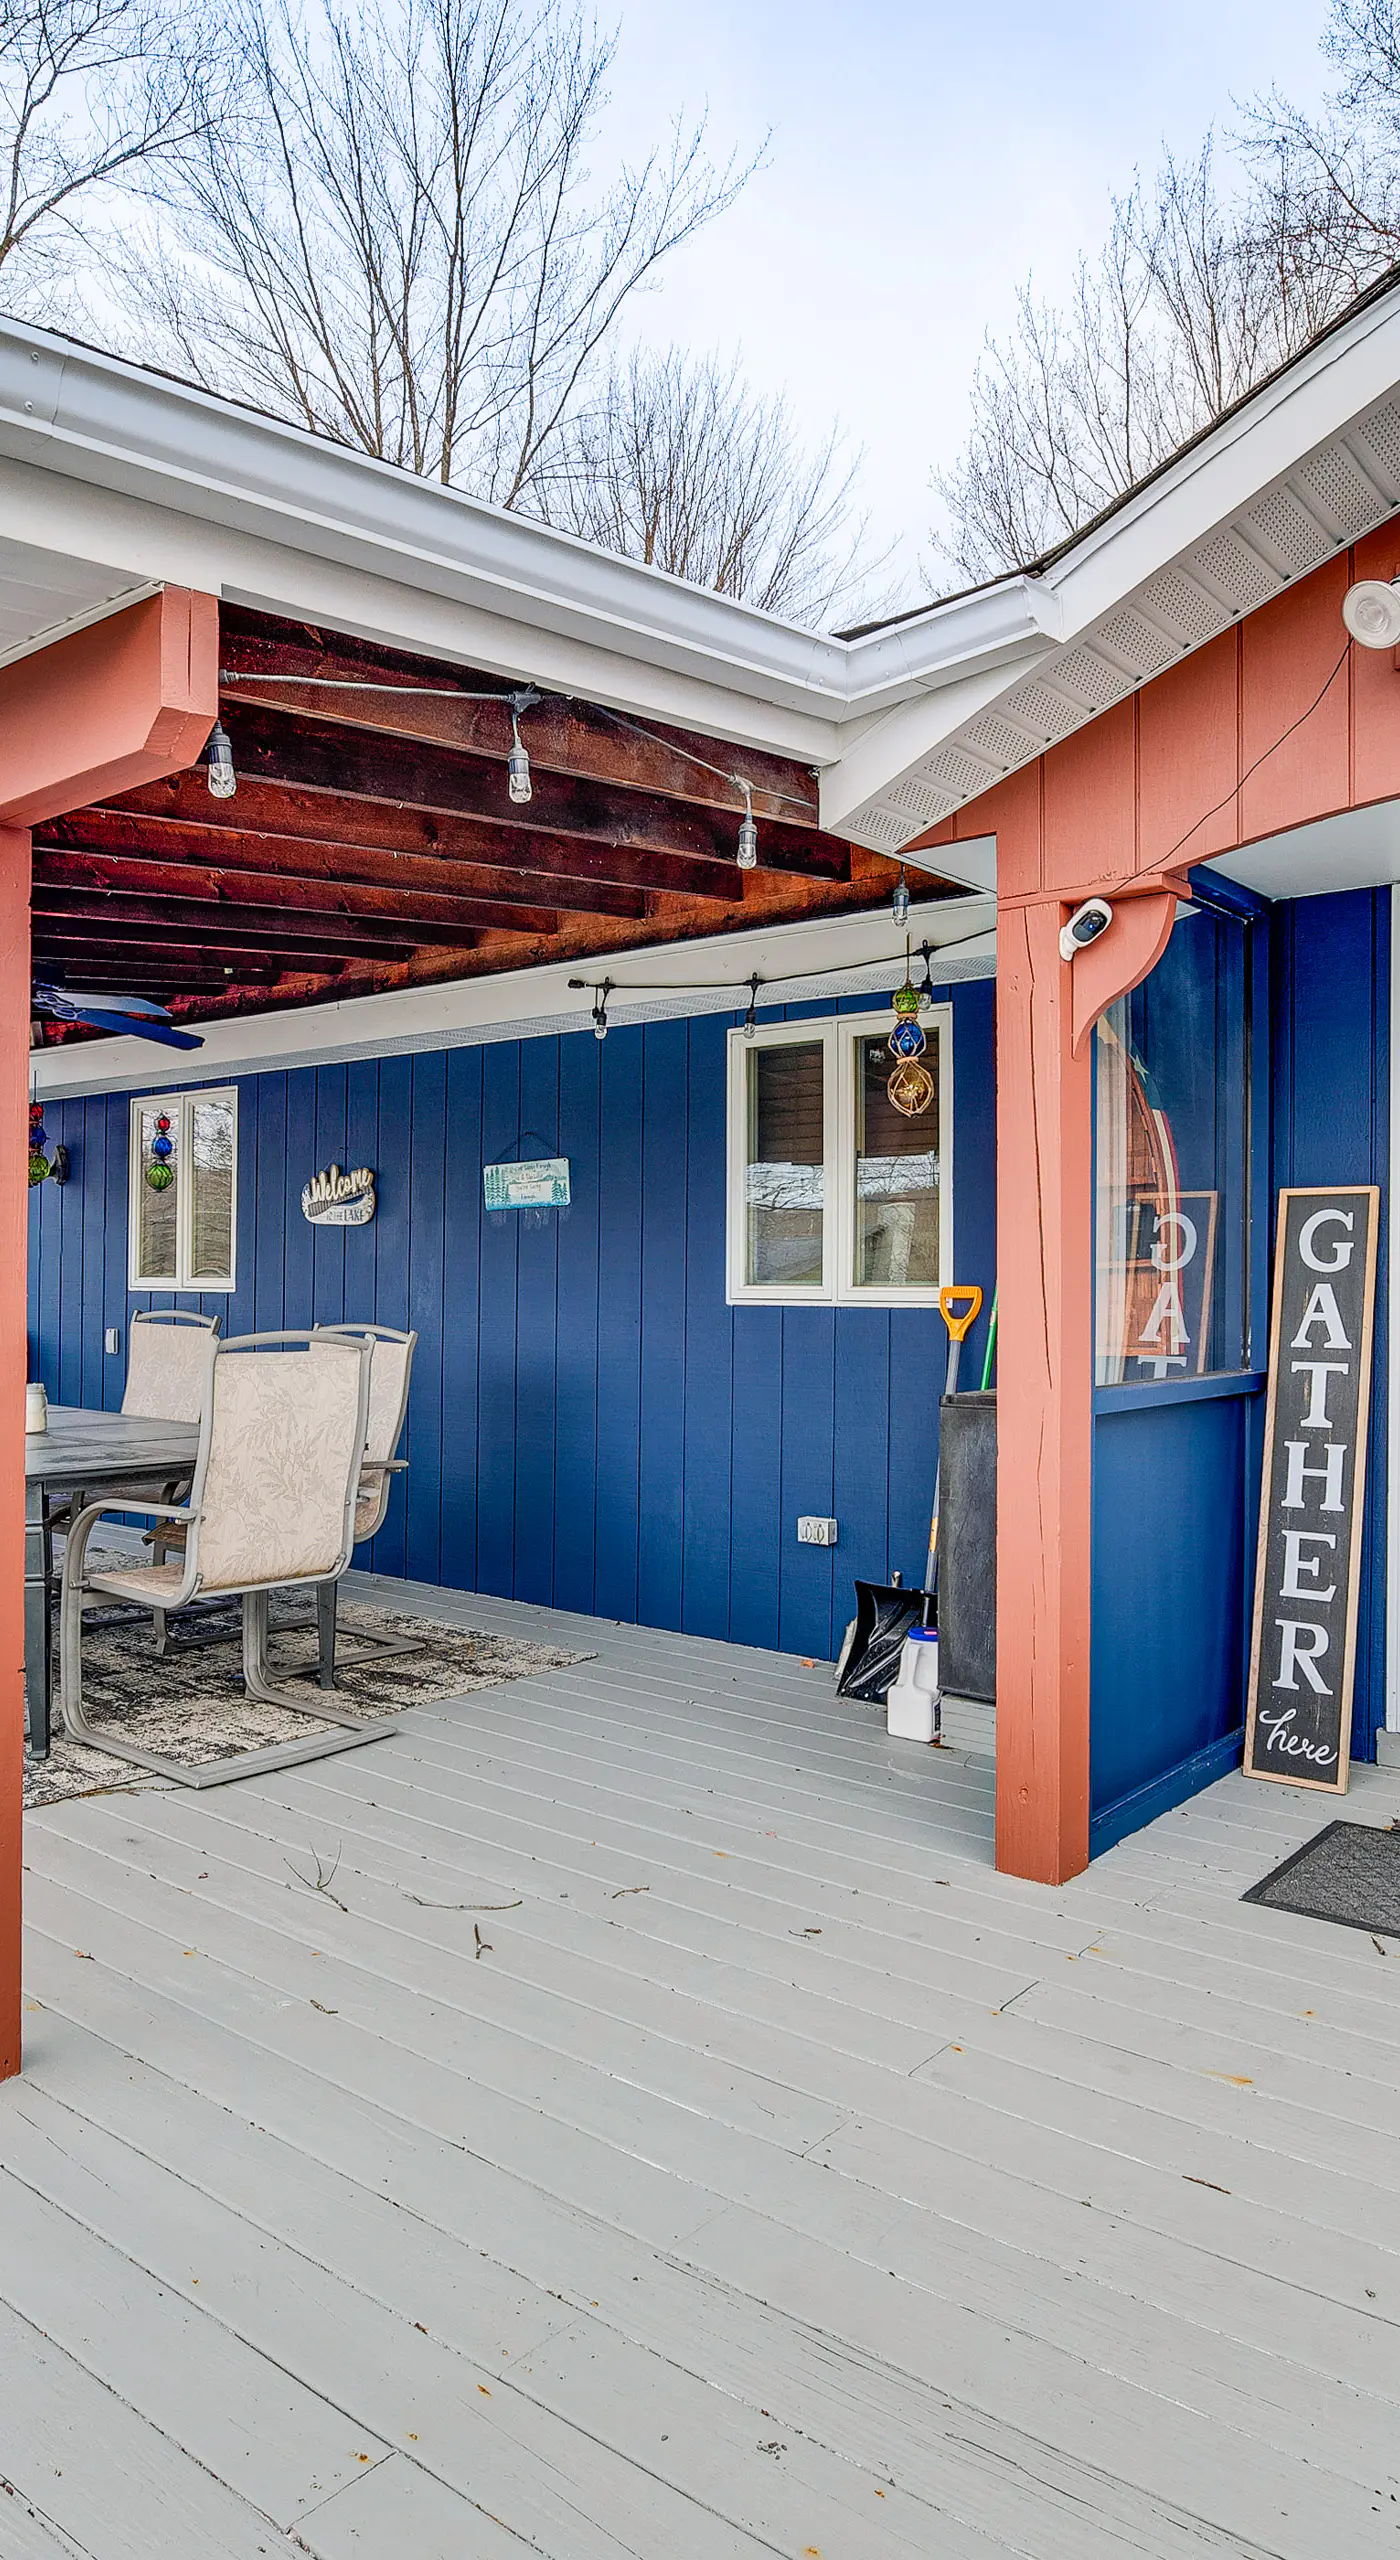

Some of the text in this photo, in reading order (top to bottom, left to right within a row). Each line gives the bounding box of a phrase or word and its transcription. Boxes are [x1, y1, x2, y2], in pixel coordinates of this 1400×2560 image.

[311, 1165, 371, 1202] Welcome
[344, 1208, 364, 1222] LAKE
[1272, 1208, 1355, 1695] GATHER
[1259, 1708, 1337, 1766] here
